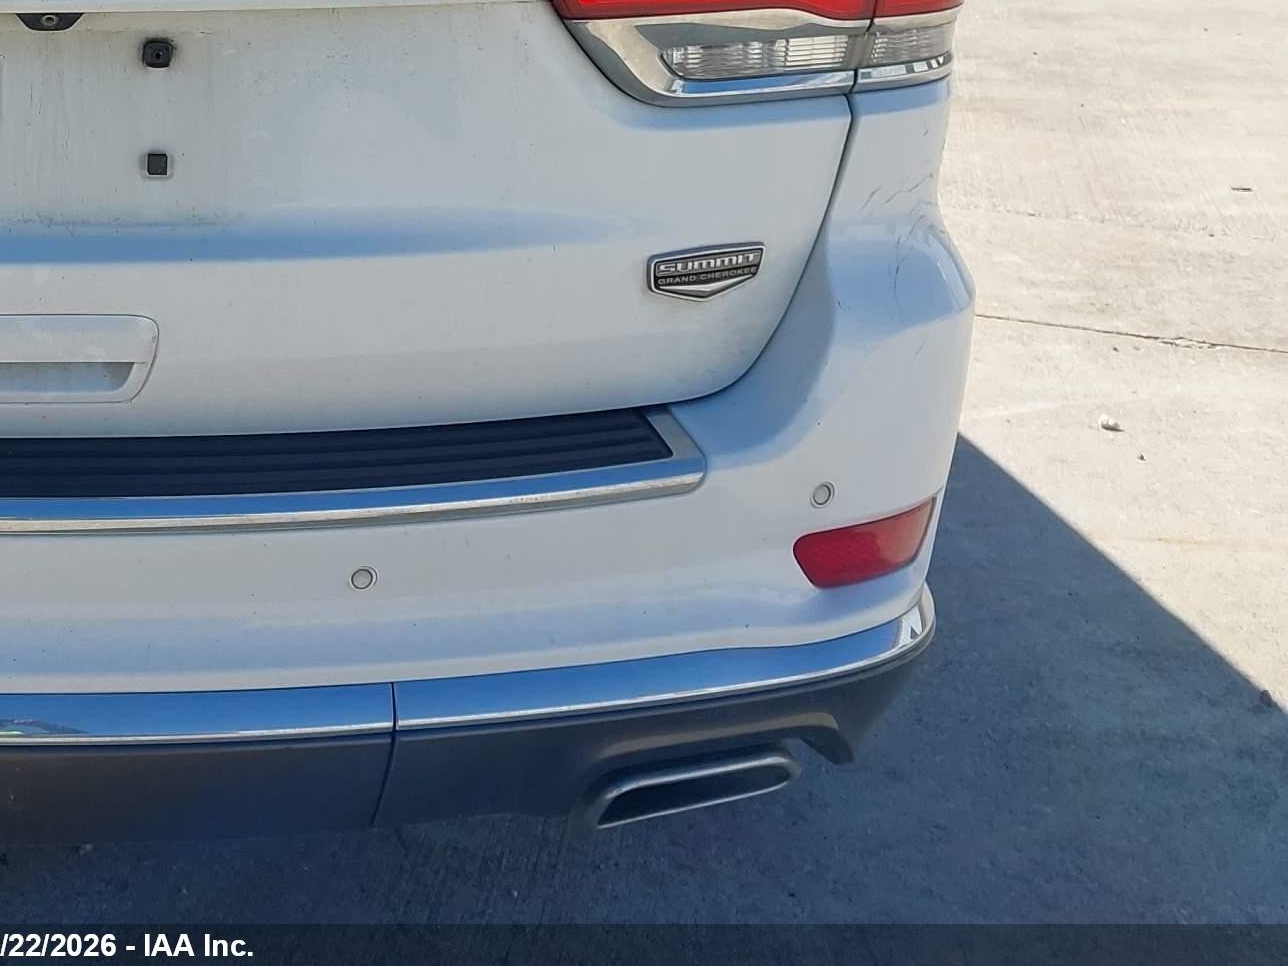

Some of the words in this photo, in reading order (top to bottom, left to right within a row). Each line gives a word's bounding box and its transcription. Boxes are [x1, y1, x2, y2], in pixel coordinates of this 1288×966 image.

[657, 251, 761, 276] SUMMIT
[657, 274, 697, 286] GRAND
[699, 266, 758, 280] CHEROKEE
